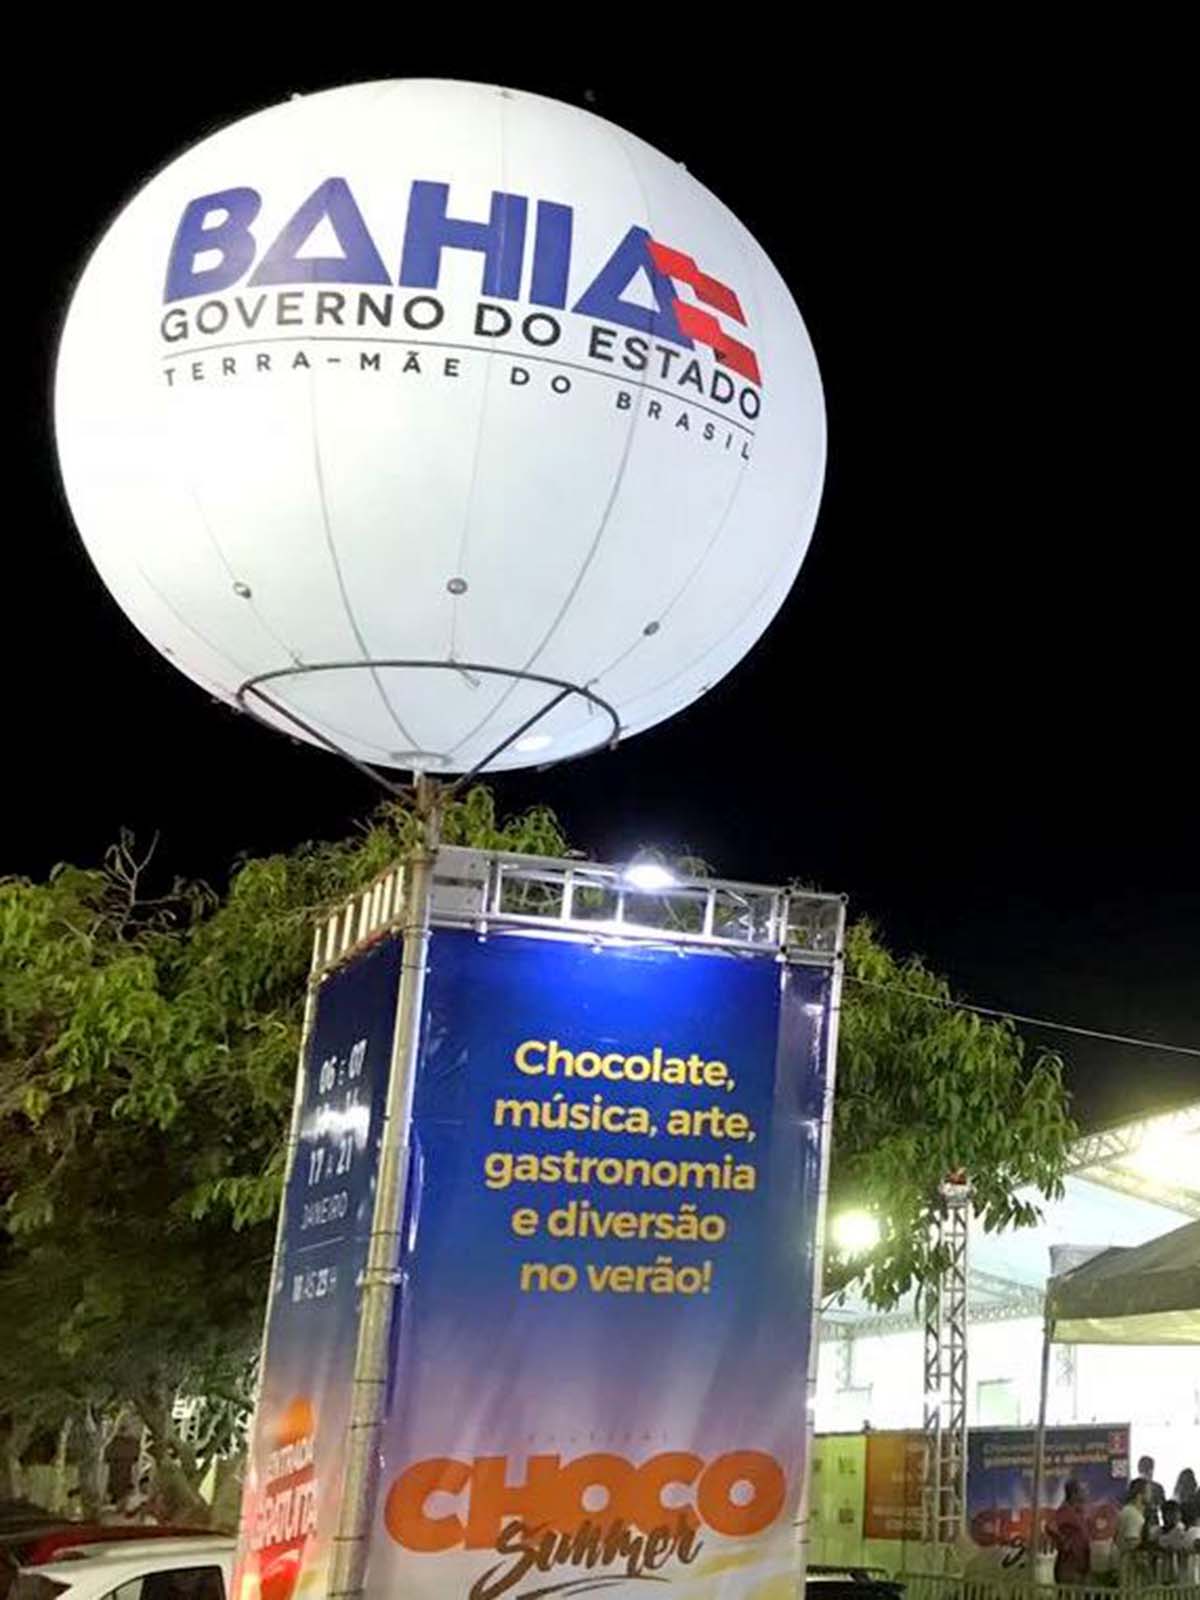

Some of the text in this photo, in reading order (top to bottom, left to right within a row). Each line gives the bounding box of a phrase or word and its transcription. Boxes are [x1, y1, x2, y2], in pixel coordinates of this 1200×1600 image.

[162, 176, 696, 350] BAHIA
[160, 291, 763, 422] GOVERNO DO ESTADO
[511, 367, 572, 395] DO
[617, 391, 752, 461] BRASIL
[514, 1040, 736, 1091] Chocolate,
[494, 1092, 757, 1143] música, arte,
[484, 1147, 756, 1191] gastronomia
[512, 1201, 727, 1241] e diversão
[520, 1254, 712, 1293] no verão!
[384, 1449, 787, 1552] CHOCO
[469, 1514, 704, 1599] Summer
